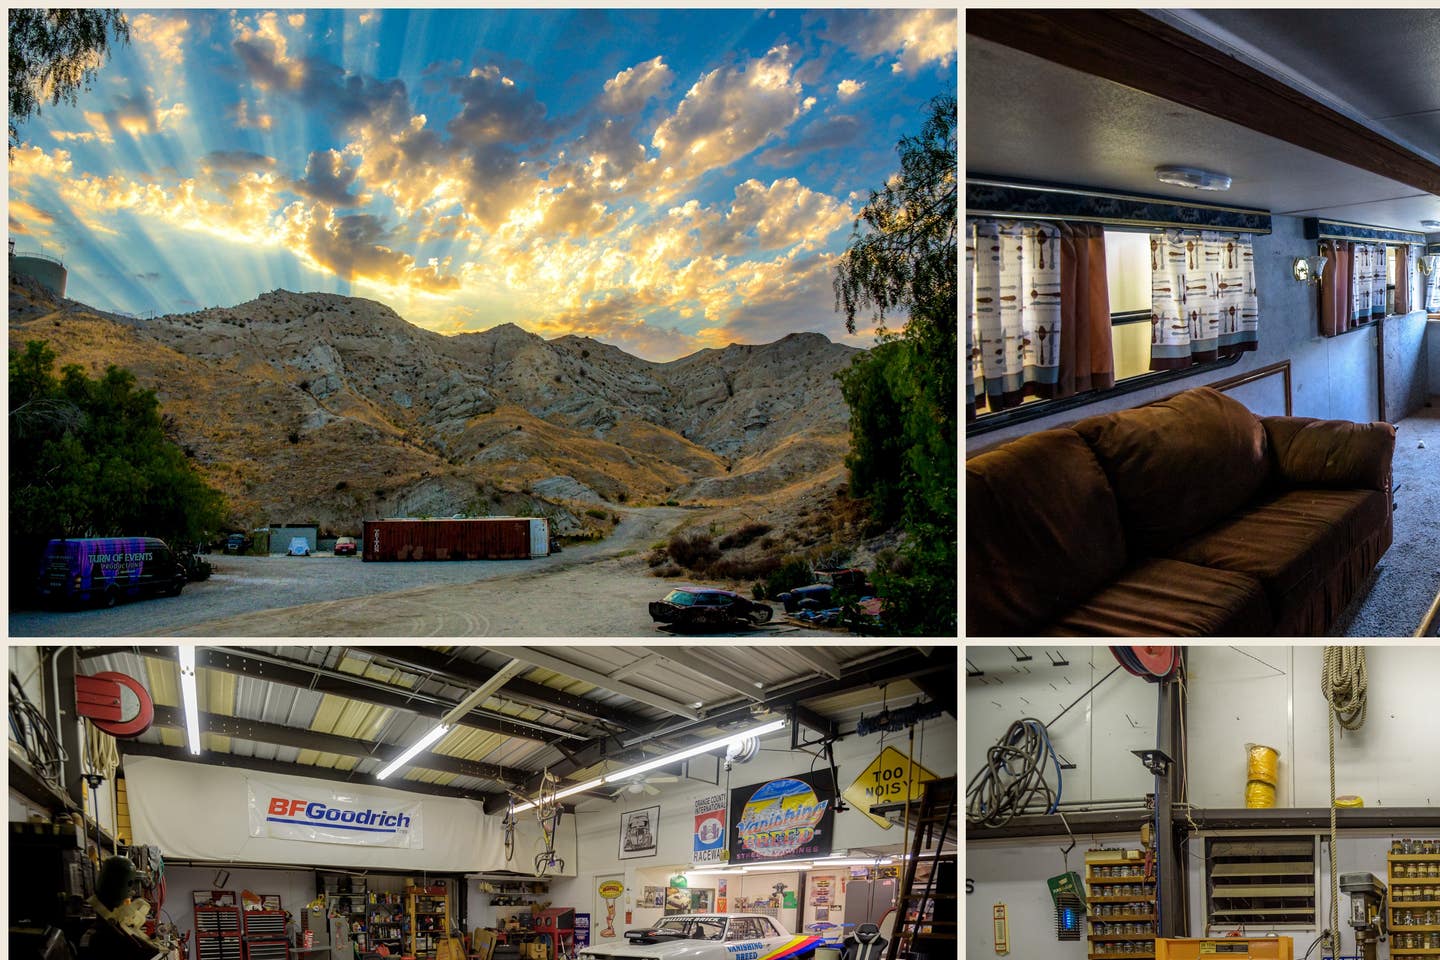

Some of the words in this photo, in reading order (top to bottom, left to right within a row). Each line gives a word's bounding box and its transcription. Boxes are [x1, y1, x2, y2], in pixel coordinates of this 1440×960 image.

[88, 554, 111, 564] TURN
[112, 553, 124, 562] OF
[124, 551, 153, 562] EVENTS
[872, 766, 903, 783] TOO
[865, 779, 913, 798] NOISY
[694, 797, 711, 808] ORANGE
[267, 797, 411, 828] BFGoodrich
[693, 850, 723, 862] RACEWA
[727, 941, 764, 953] VANISHING
